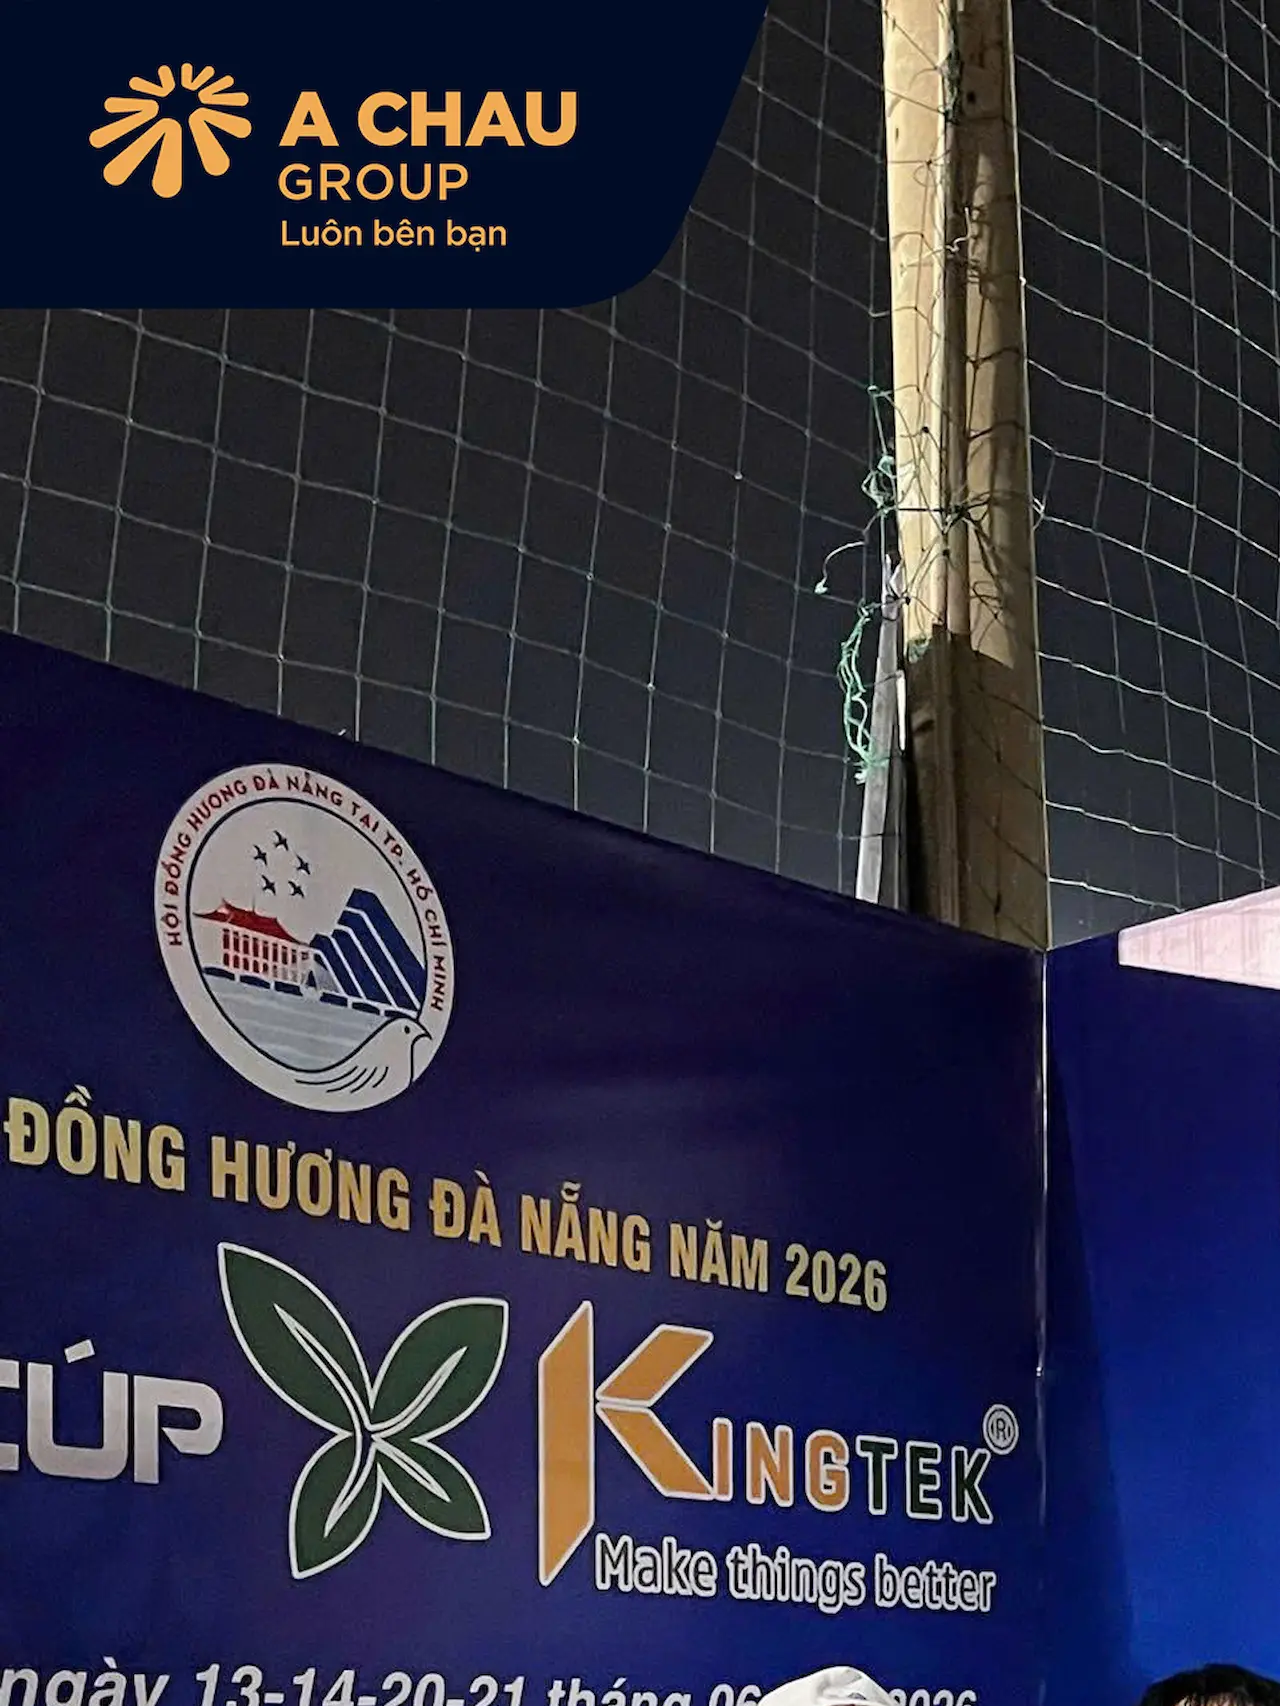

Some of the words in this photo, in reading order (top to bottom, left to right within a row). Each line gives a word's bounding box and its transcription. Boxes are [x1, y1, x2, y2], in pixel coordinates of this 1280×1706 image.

[431, 956, 447, 1012] MINH
[3, 1084, 186, 1192] ĐỒNG
[211, 1135, 411, 1232] HƯƠNG
[429, 1169, 502, 1248] ĐÀ
[520, 1180, 651, 1273] NẴNG
[669, 1218, 769, 1293] NĂM
[785, 1242, 887, 1312] 2026
[0, 1339, 224, 1485] ÚP
[538, 1299, 993, 1587] KINGTEK
[594, 1532, 717, 1595] Make
[726, 1542, 866, 1614] things
[874, 1553, 996, 1612] better
